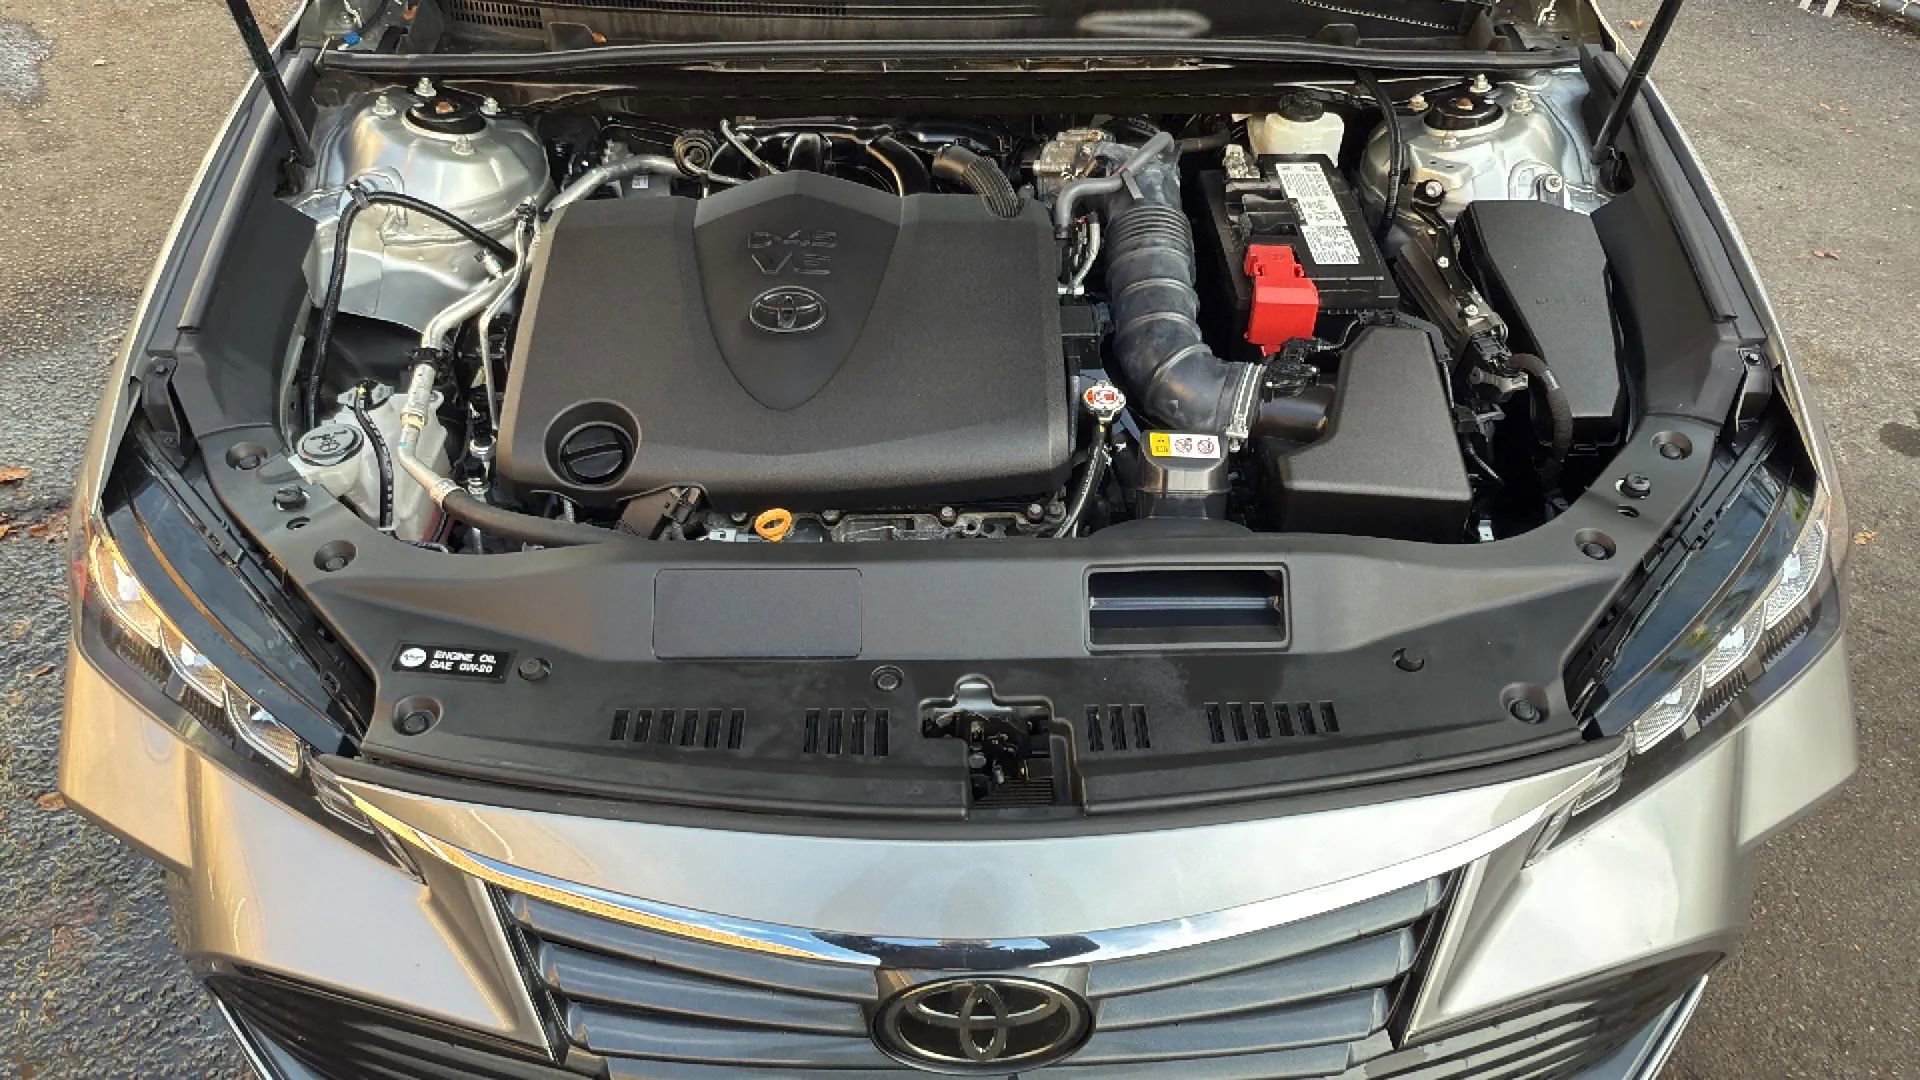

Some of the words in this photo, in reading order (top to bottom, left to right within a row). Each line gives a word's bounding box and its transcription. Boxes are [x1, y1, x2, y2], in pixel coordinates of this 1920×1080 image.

[751, 251, 831, 275] V6
[433, 650, 475, 662] ENGINE
[479, 654, 497, 664] OIL
[429, 660, 454, 670] SAE
